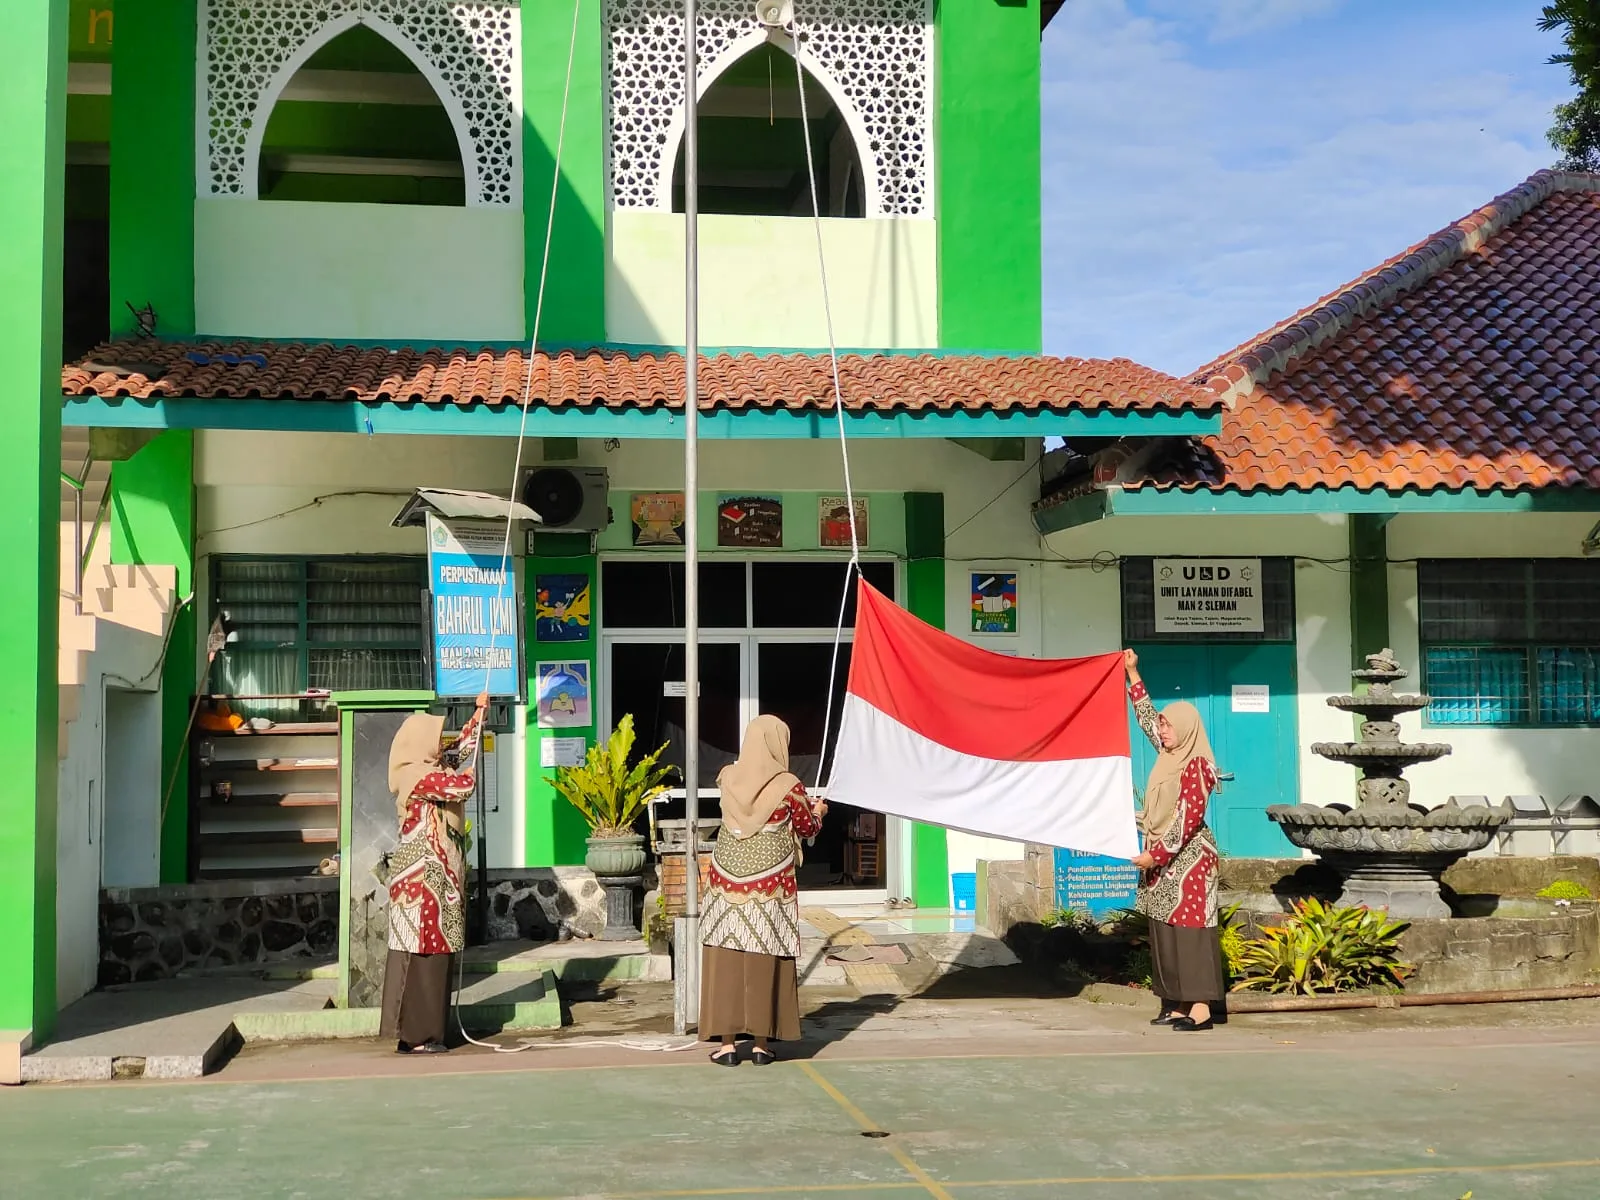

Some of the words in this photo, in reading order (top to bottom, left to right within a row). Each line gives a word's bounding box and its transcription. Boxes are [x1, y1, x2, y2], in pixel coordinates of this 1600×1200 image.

[440, 565, 507, 585] PERPUSTAKAAN
[1161, 587, 1179, 597] UNIT
[1181, 587, 1219, 597] LAYANAN
[1221, 587, 1253, 597] DIFABEL
[1178, 600, 1196, 611] MAN
[1197, 600, 1203, 611] 2
[1205, 600, 1237, 611] SLEMAN
[437, 596, 486, 635] BAHRUL
[440, 647, 462, 669] MAN
[464, 646, 472, 669] 2
[473, 646, 512, 669] SLEMAN
[1068, 891, 1103, 899] Kehidupan
[1103, 890, 1129, 898] Sekolah
